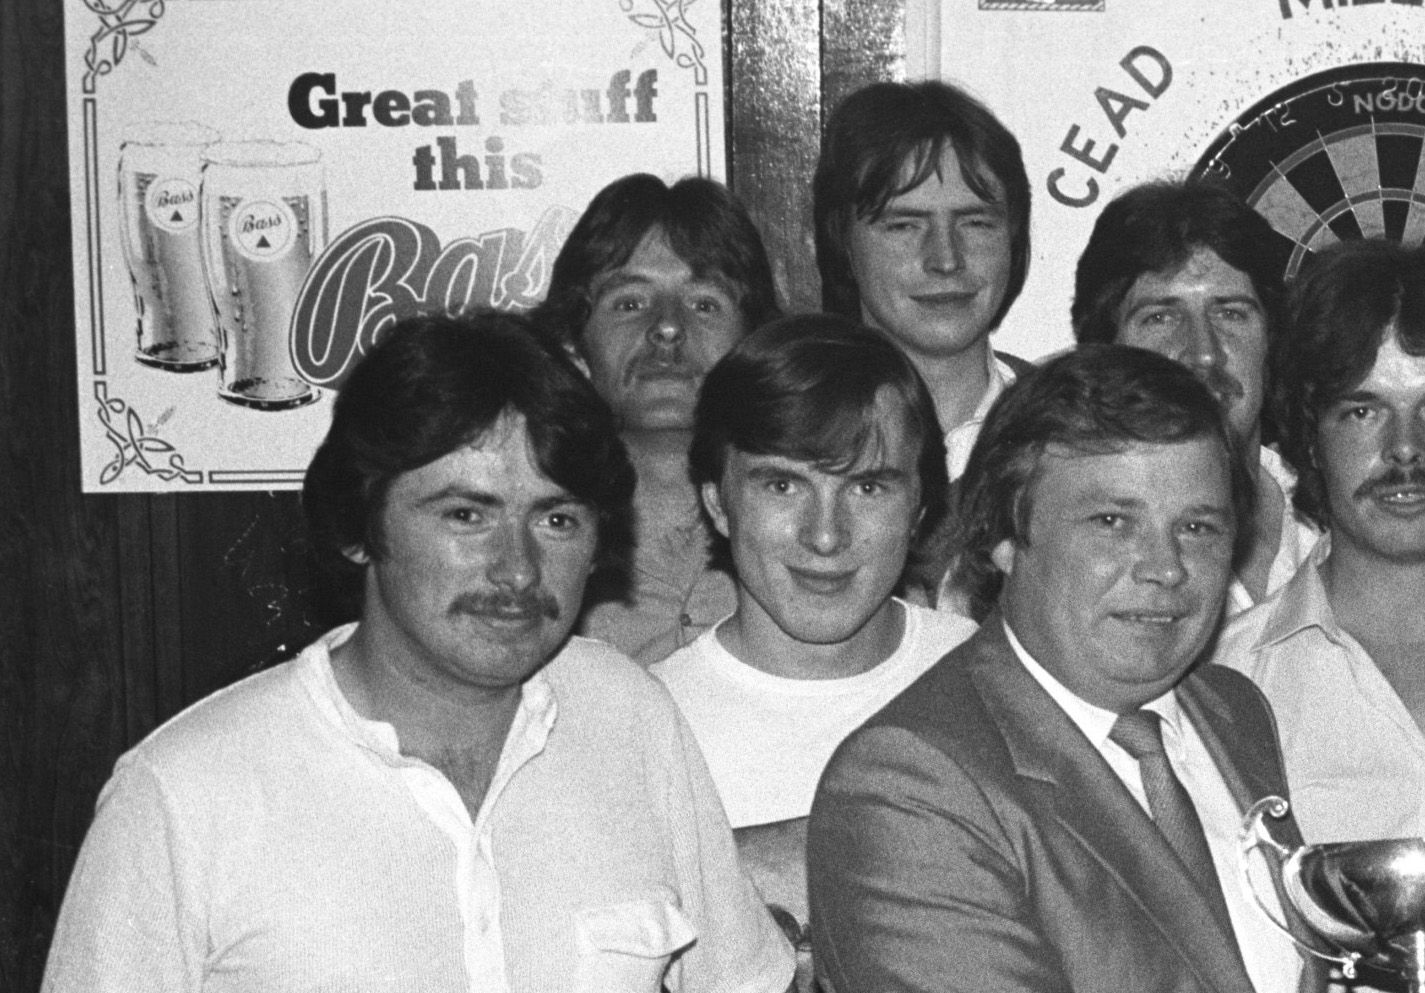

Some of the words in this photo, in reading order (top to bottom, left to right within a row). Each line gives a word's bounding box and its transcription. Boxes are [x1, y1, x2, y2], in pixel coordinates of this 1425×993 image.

[288, 72, 480, 130] Great
[1046, 45, 1173, 208] CEAD
[412, 136, 544, 191] this
[156, 190, 194, 208] Bass
[242, 213, 282, 234] Bass
[288, 205, 582, 388] Bas
